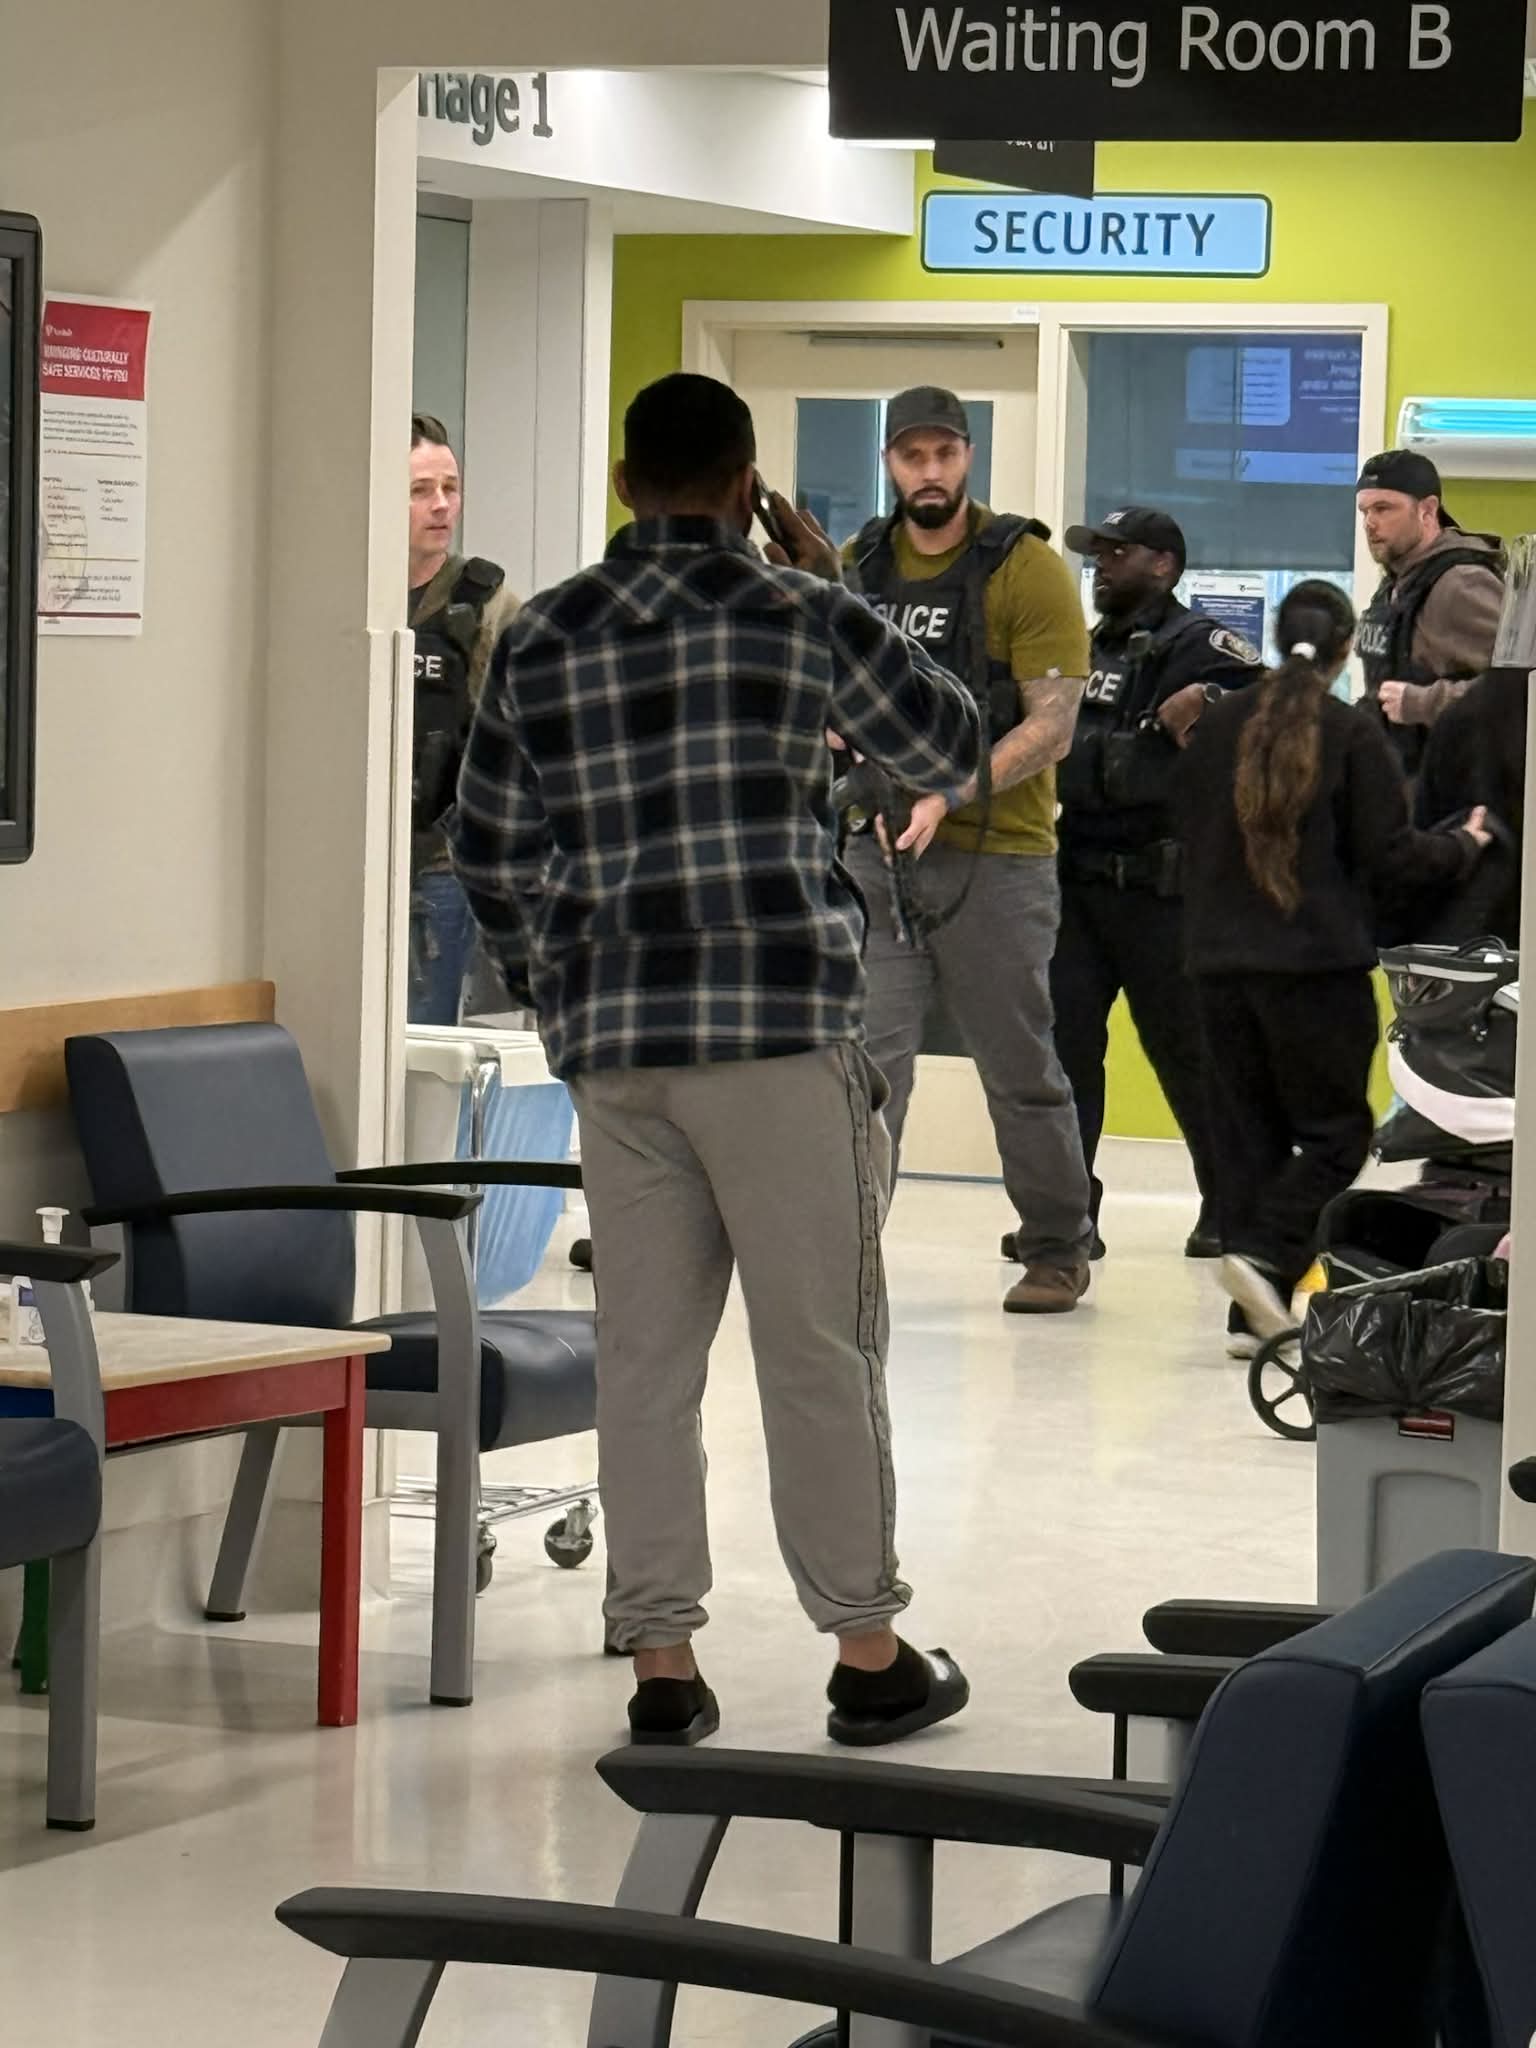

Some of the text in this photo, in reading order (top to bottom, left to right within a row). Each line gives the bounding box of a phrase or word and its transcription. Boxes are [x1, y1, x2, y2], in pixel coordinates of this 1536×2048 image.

[896, 4, 1453, 88] Waiting Room B
[532, 72, 553, 138] 1
[974, 209, 1216, 258] SECURITY
[1085, 669, 1122, 701] CE
